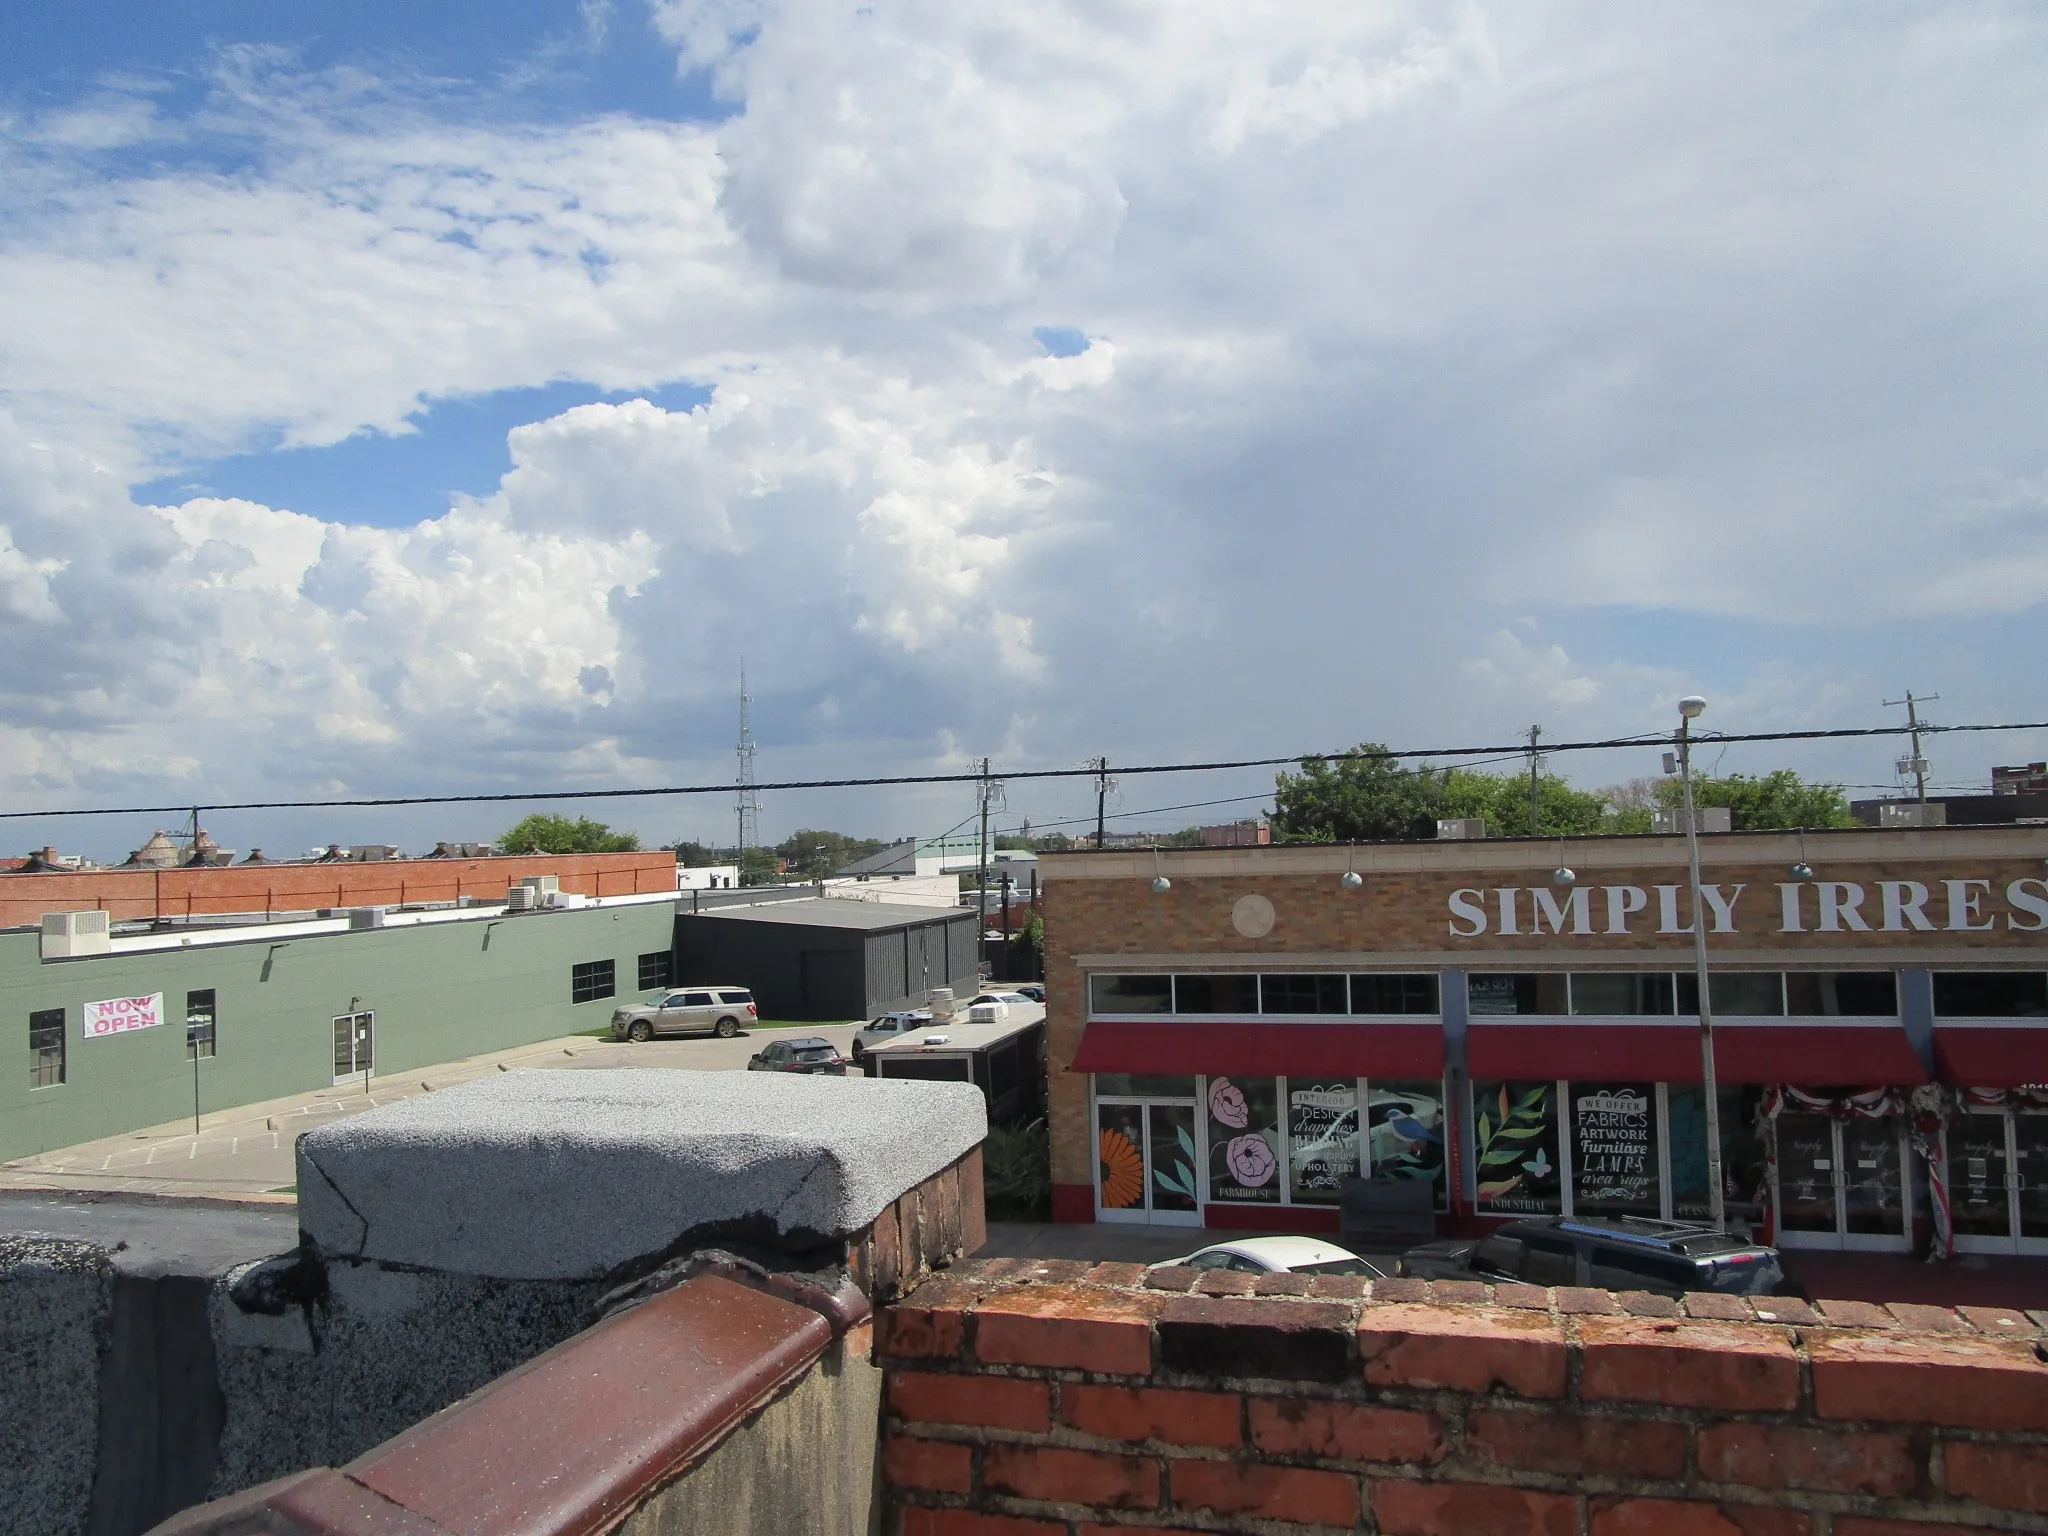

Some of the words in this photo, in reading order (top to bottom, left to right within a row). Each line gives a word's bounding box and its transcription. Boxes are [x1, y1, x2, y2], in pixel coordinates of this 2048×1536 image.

[1448, 882, 1747, 937] SIMPLY
[1776, 877, 2048, 934] IRRES
[99, 996, 152, 1016] NOW
[94, 1012, 156, 1034] OPEN
[1299, 1093, 1345, 1106] INTERIOR
[1585, 1100, 1601, 1108] WE
[1606, 1101, 1641, 1111] OFFER
[1302, 1107, 1354, 1120] DESIGN
[1578, 1112, 1648, 1128] FABRICS
[1294, 1118, 1354, 1136] drapeies
[1579, 1127, 1648, 1140] ARTWORK
[1295, 1163, 1355, 1174] UPHOLSTERY
[1583, 1154, 1645, 1173] LAMPS
[1582, 1174, 1614, 1185] area
[1219, 1187, 1271, 1199] FARMHOUSE
[1490, 1199, 1546, 1211] INDUSTRIAL
